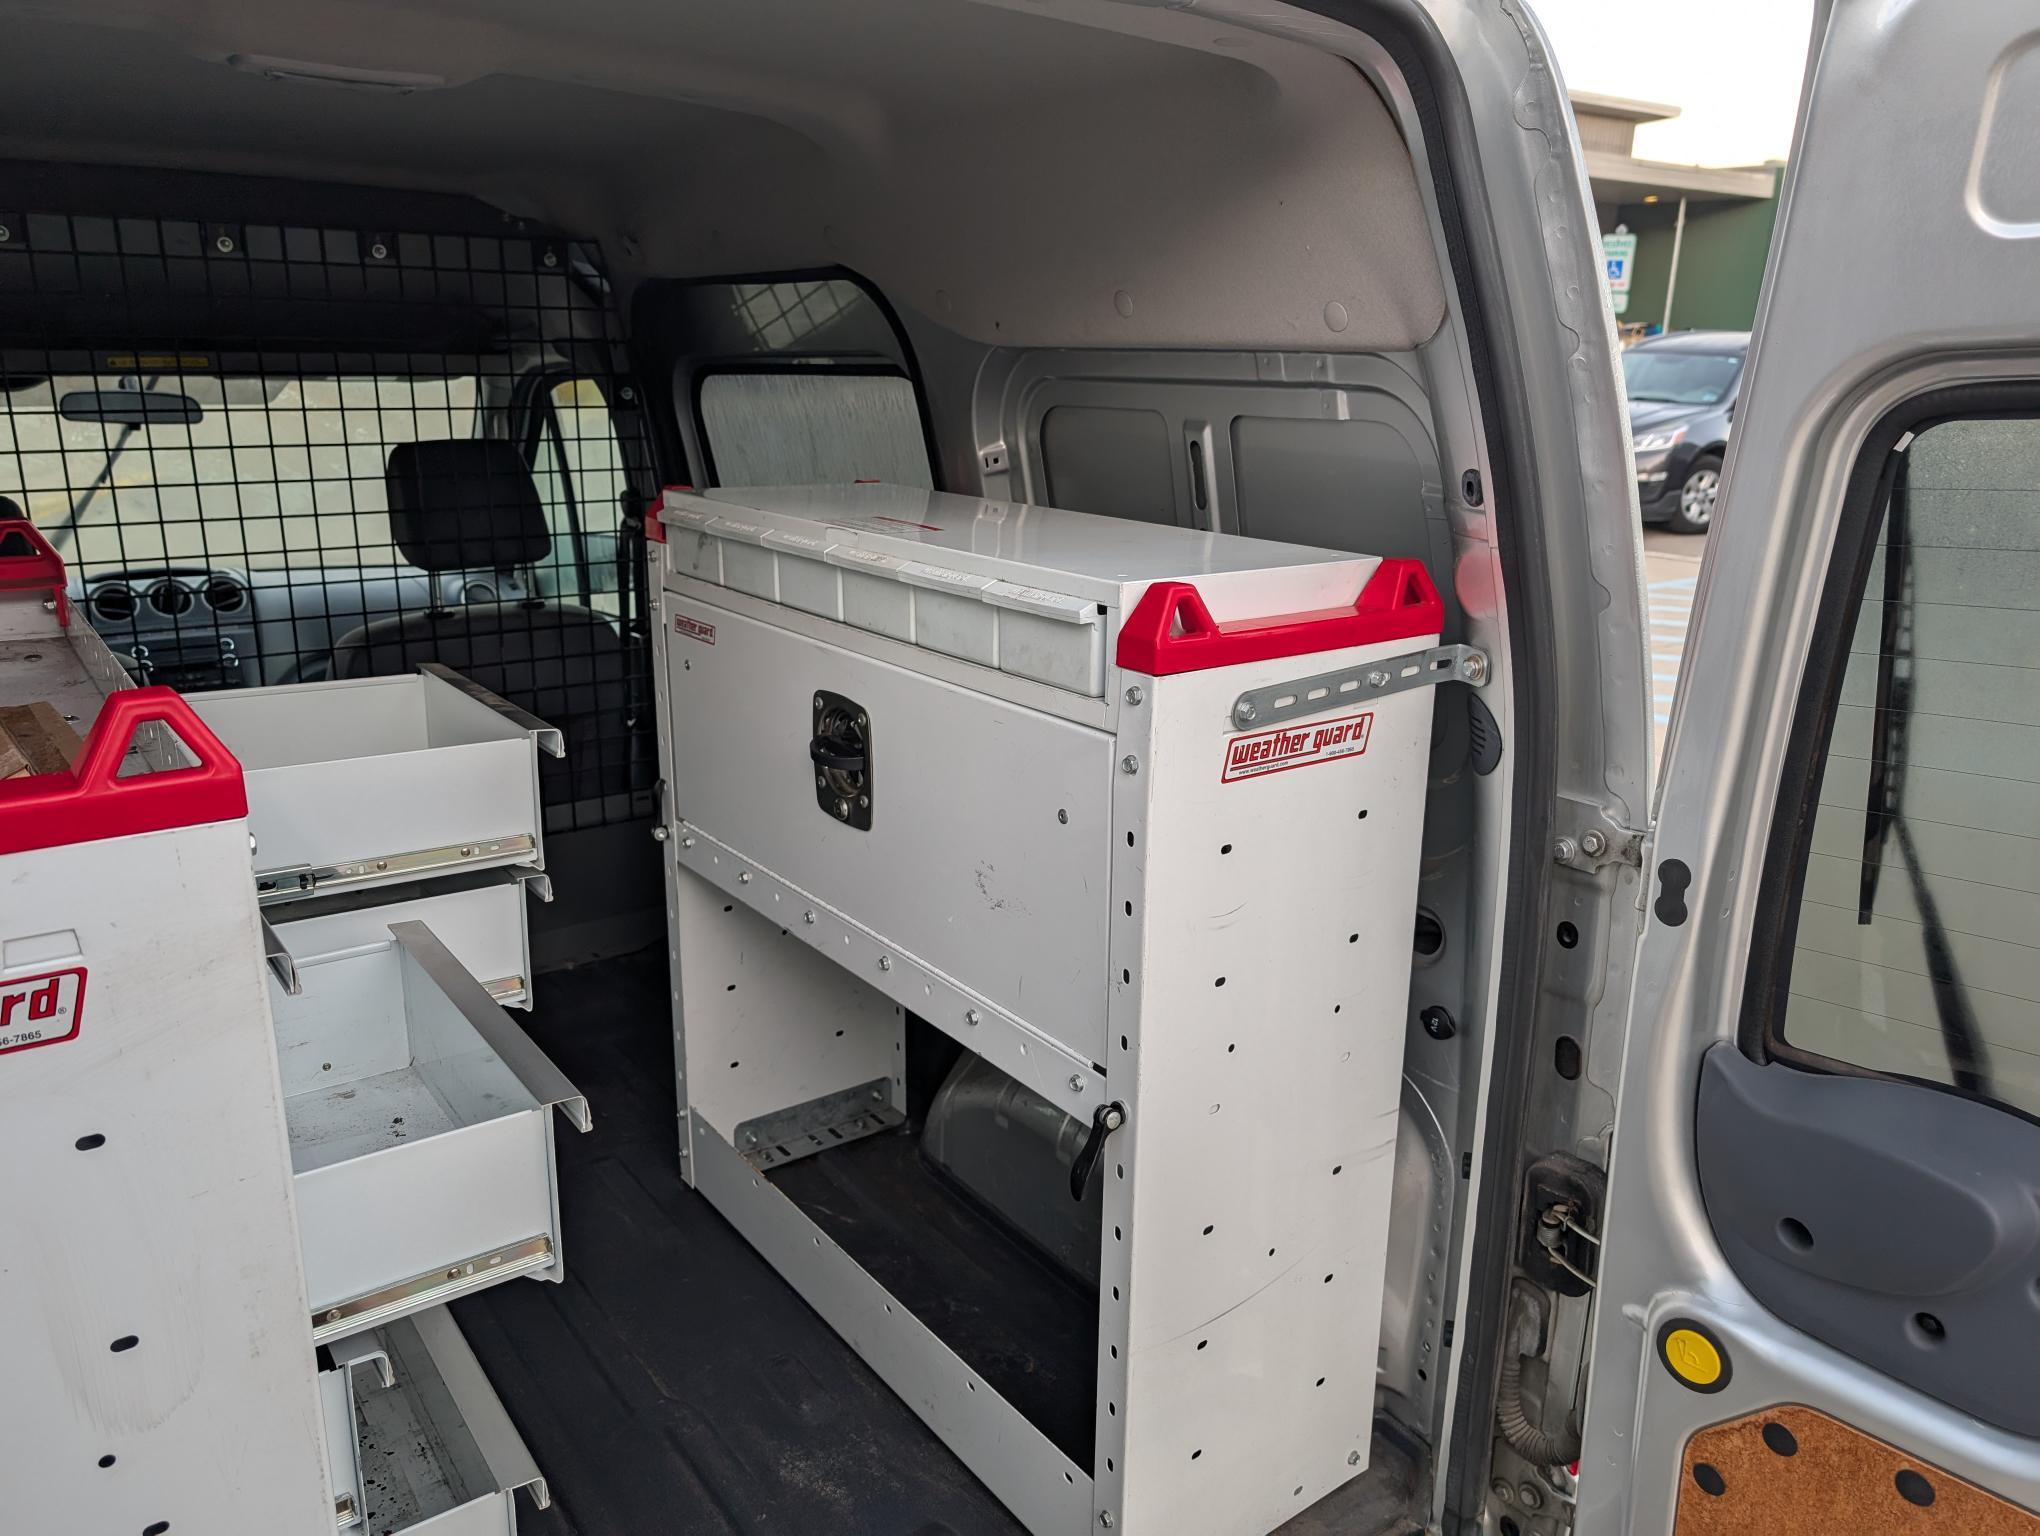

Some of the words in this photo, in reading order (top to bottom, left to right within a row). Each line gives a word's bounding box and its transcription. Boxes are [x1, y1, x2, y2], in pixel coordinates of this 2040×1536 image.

[1231, 730, 1311, 765] weather
[1313, 716, 1365, 753] guard
[1238, 761, 1289, 775] www.weatherguard.com
[0, 1030, 42, 1046] 6-7865
